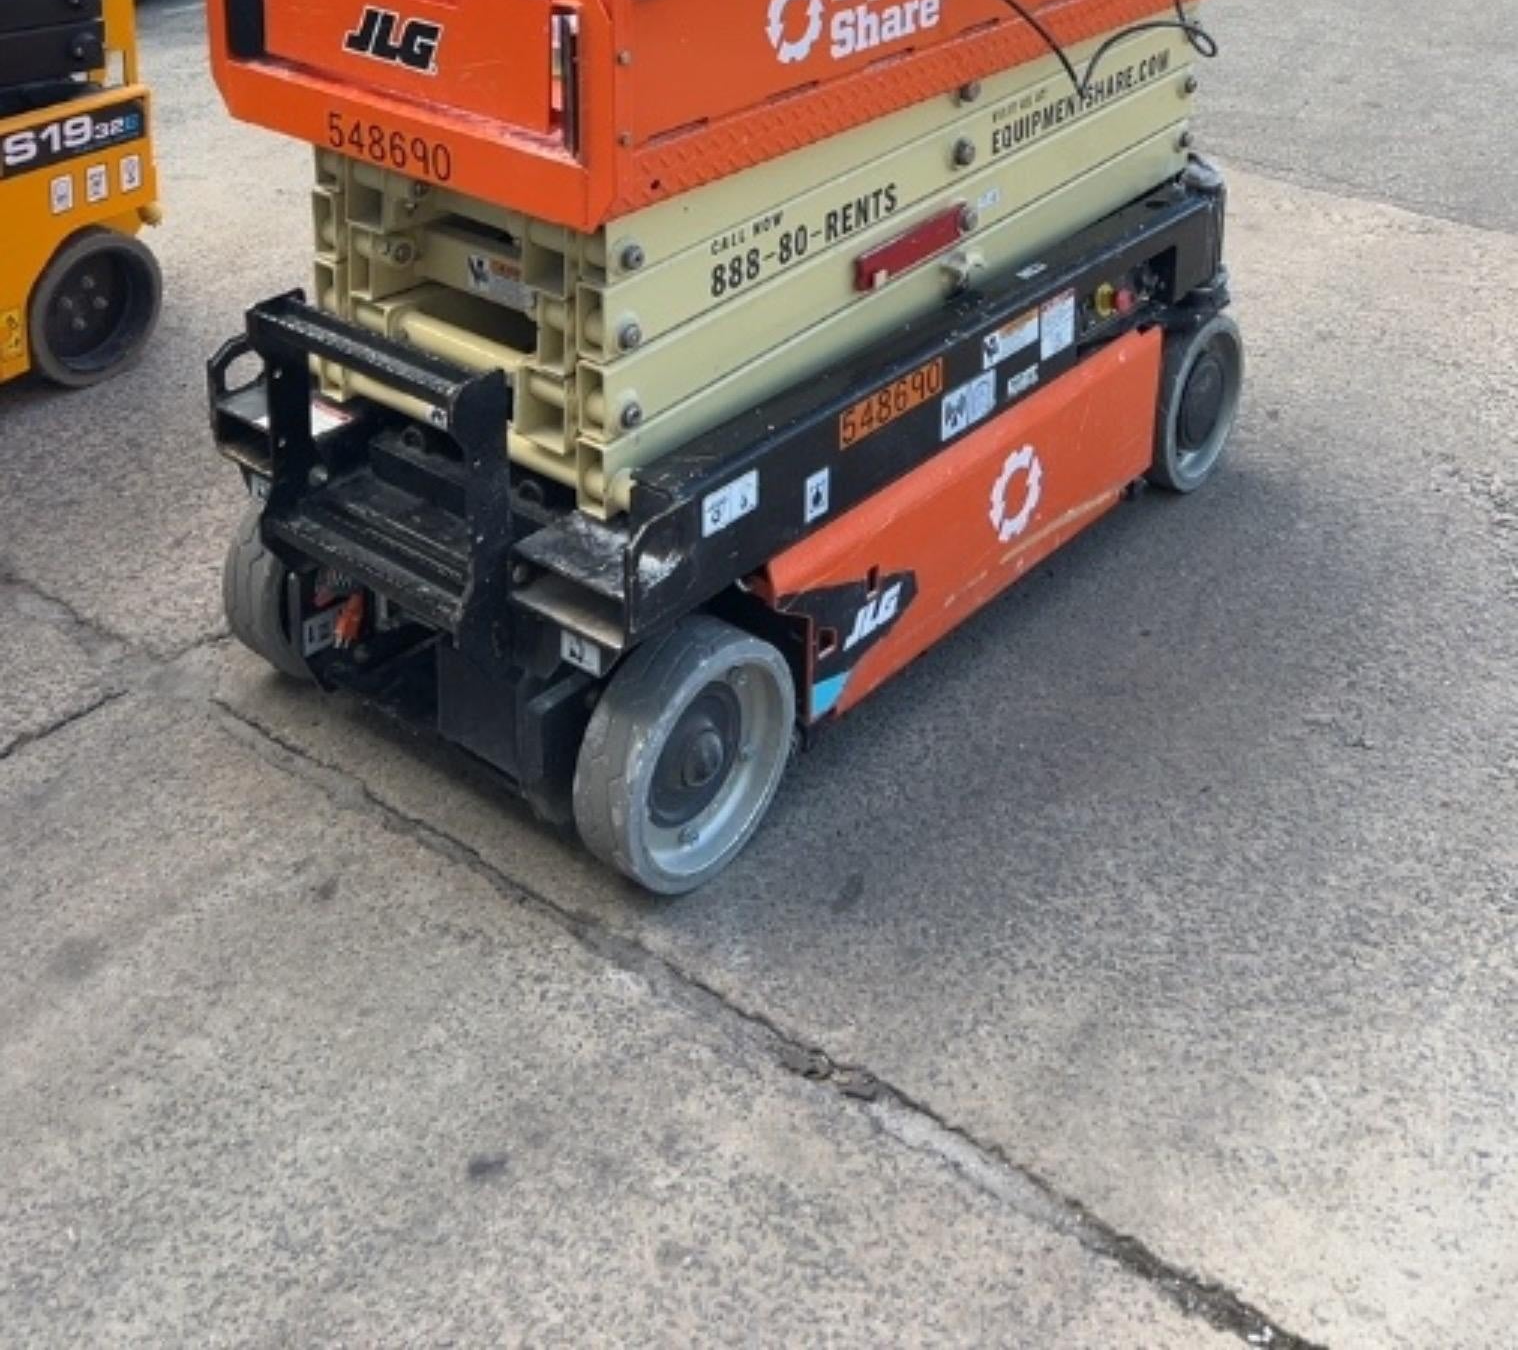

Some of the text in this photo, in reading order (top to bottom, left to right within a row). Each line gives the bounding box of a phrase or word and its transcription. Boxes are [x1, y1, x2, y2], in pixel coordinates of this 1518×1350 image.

[342, 5, 444, 76] JLG
[327, 111, 451, 181] 548690
[710, 209, 784, 256] CALL NOW
[710, 182, 898, 297] 888-80-RENTS
[842, 358, 941, 445] 548690
[842, 580, 903, 652] JLG
